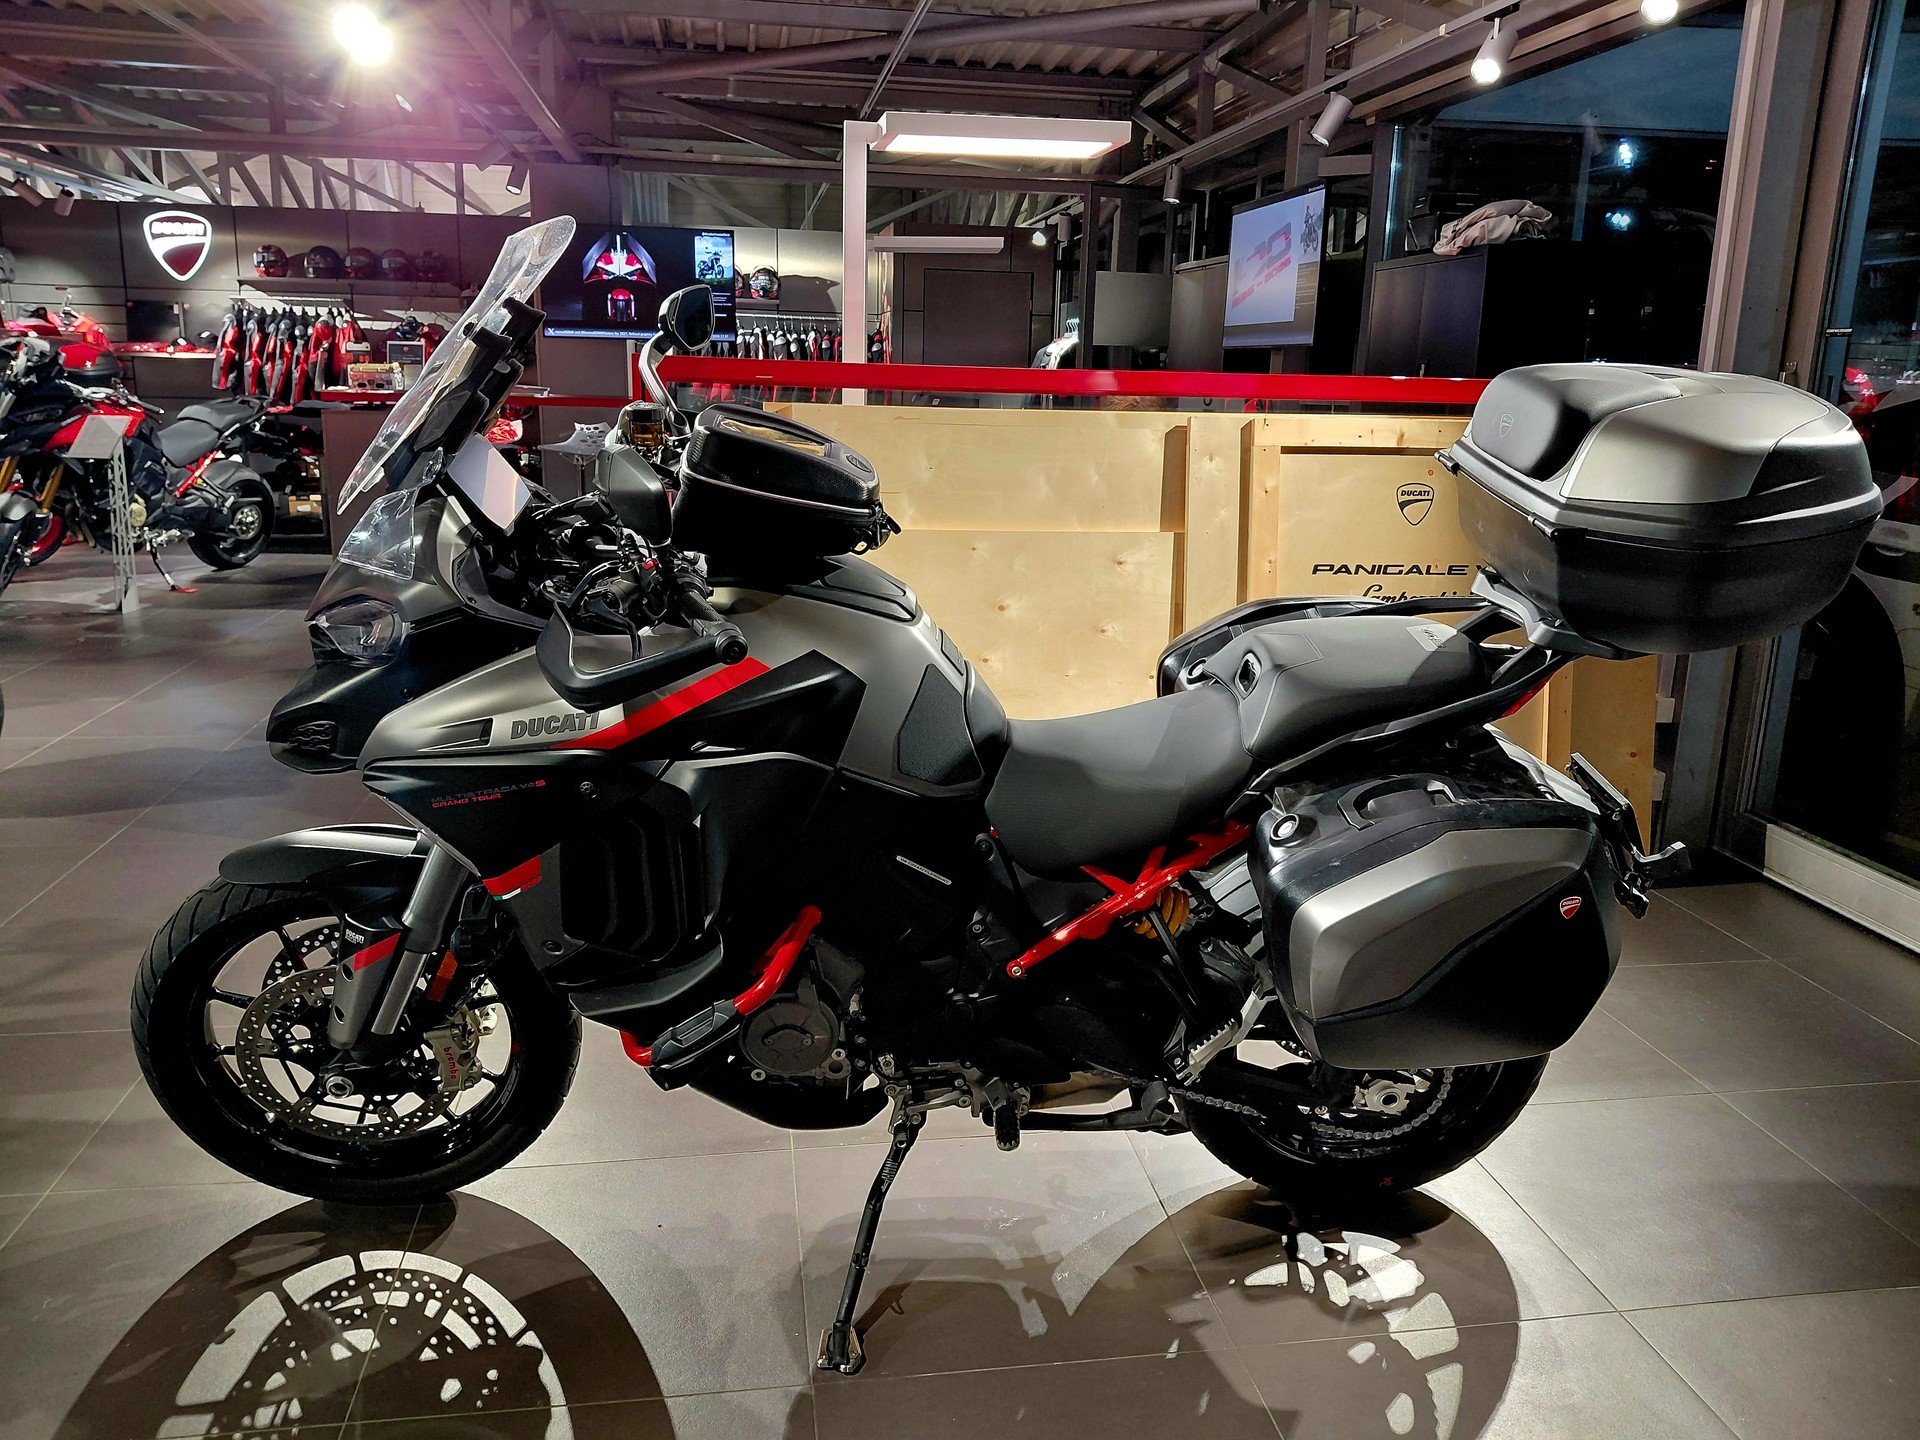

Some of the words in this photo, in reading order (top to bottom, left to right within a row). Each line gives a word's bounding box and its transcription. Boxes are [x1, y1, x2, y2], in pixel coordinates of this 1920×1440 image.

[1312, 564, 1469, 575] PANIGALE
[510, 711, 600, 740] DUCATI
[431, 785, 518, 803] MULTISTRADA
[432, 798, 469, 808] GRAND
[472, 793, 502, 802] TOUR
[443, 1046, 459, 1080] brembo
